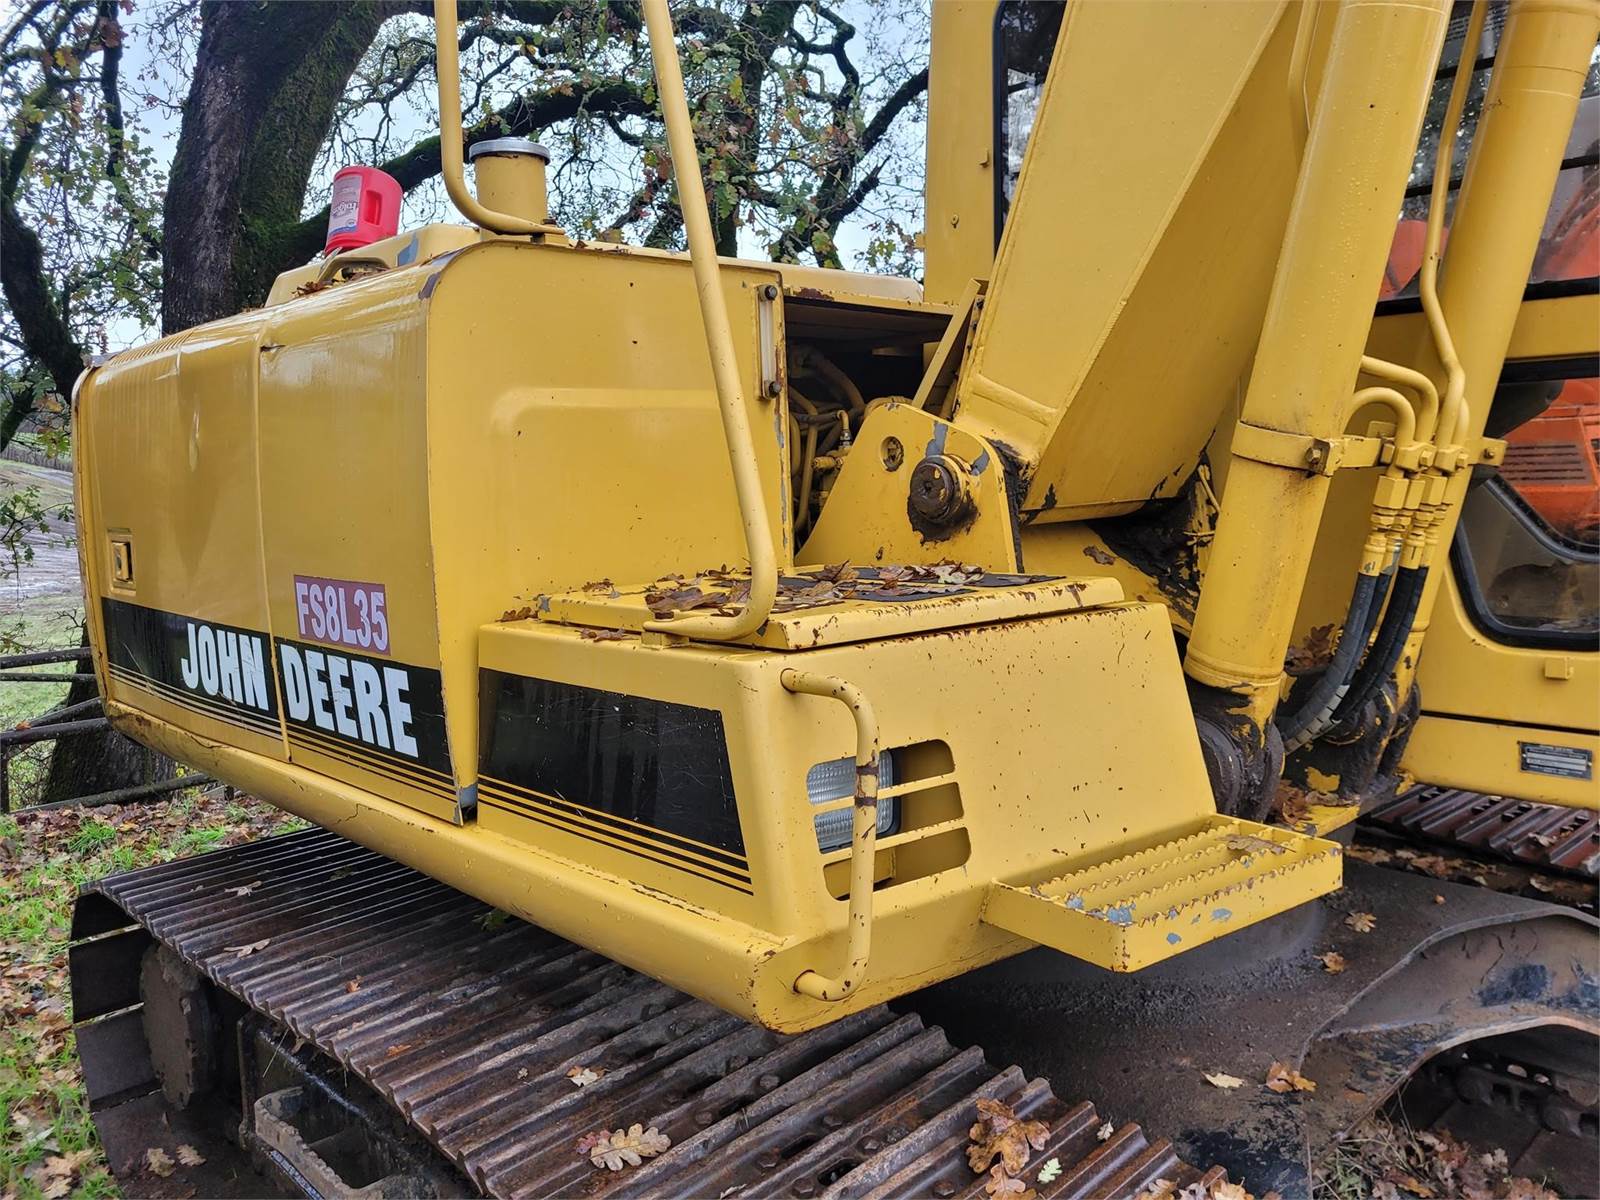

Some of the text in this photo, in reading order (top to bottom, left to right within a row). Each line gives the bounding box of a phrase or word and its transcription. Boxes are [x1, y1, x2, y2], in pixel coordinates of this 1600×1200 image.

[296, 582, 389, 651] FS8L35
[181, 622, 419, 759] JOHN DEERE
